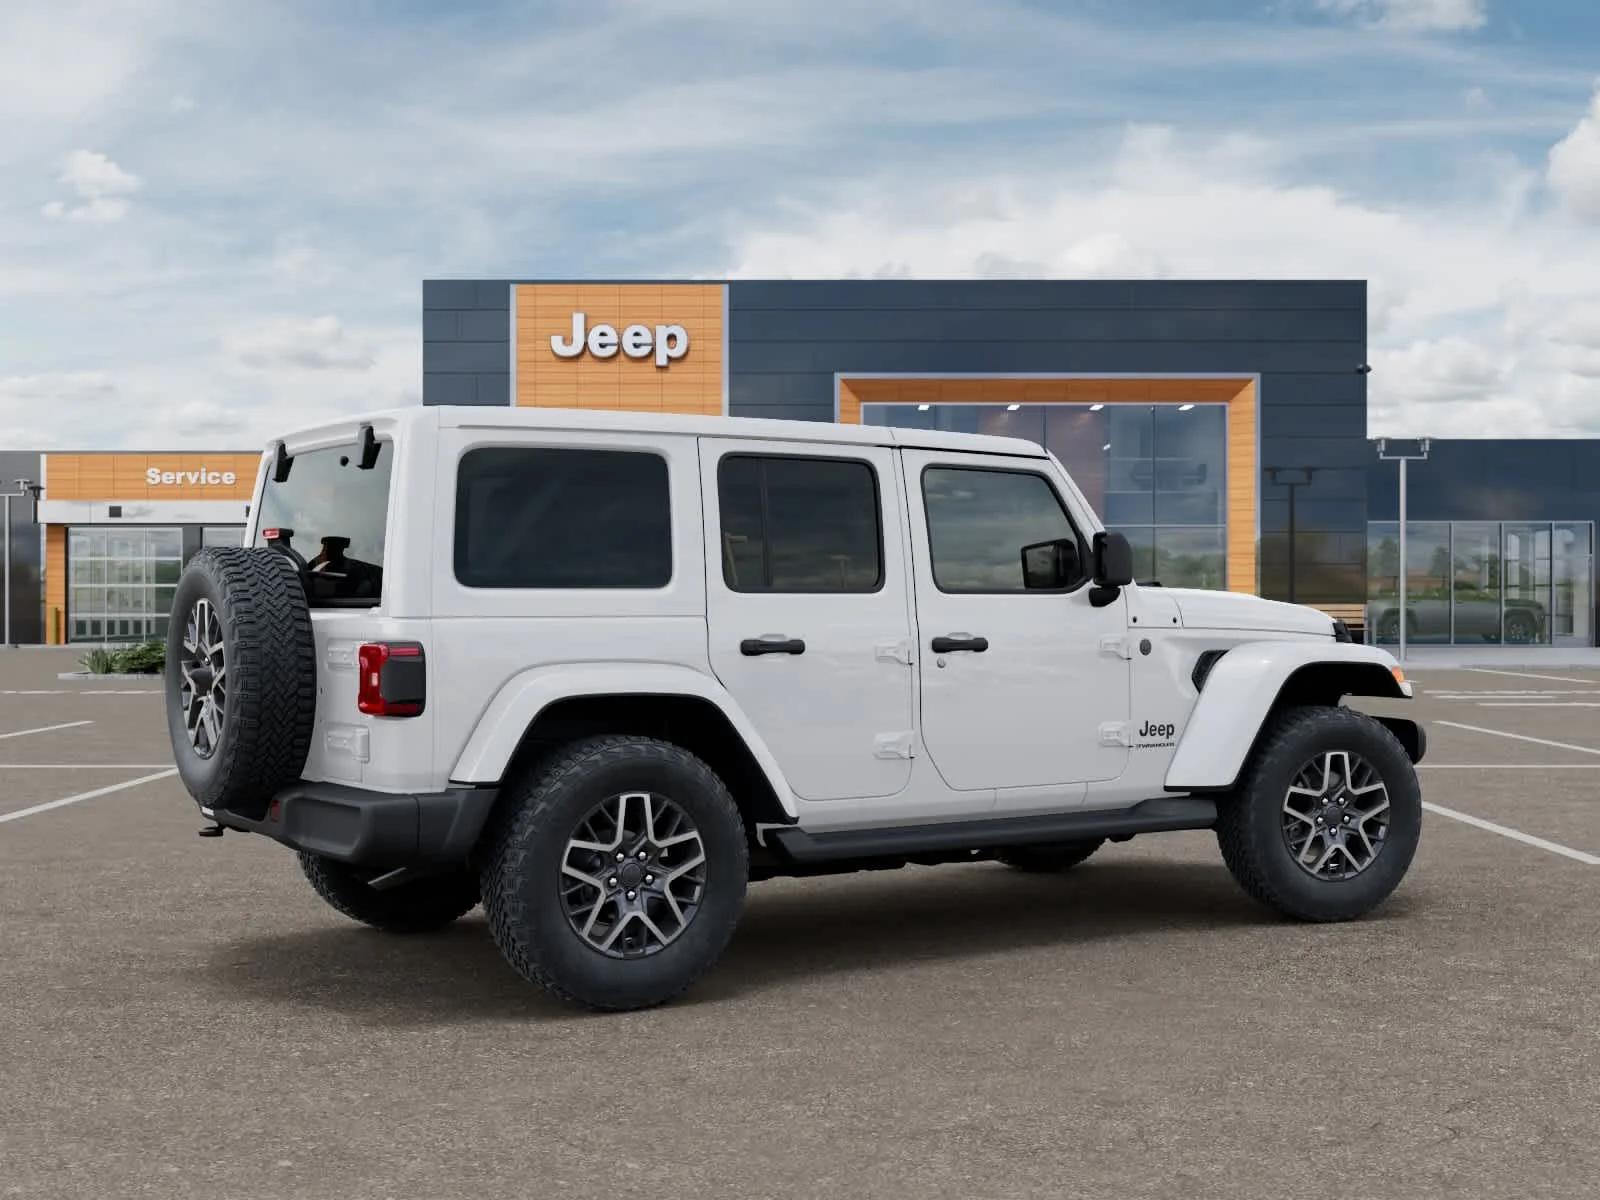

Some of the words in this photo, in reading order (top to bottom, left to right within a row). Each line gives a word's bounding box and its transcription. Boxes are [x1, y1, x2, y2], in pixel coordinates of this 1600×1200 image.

[550, 311, 689, 367] Jeep
[146, 466, 236, 485] Service
[1138, 719, 1175, 740] Jeep
